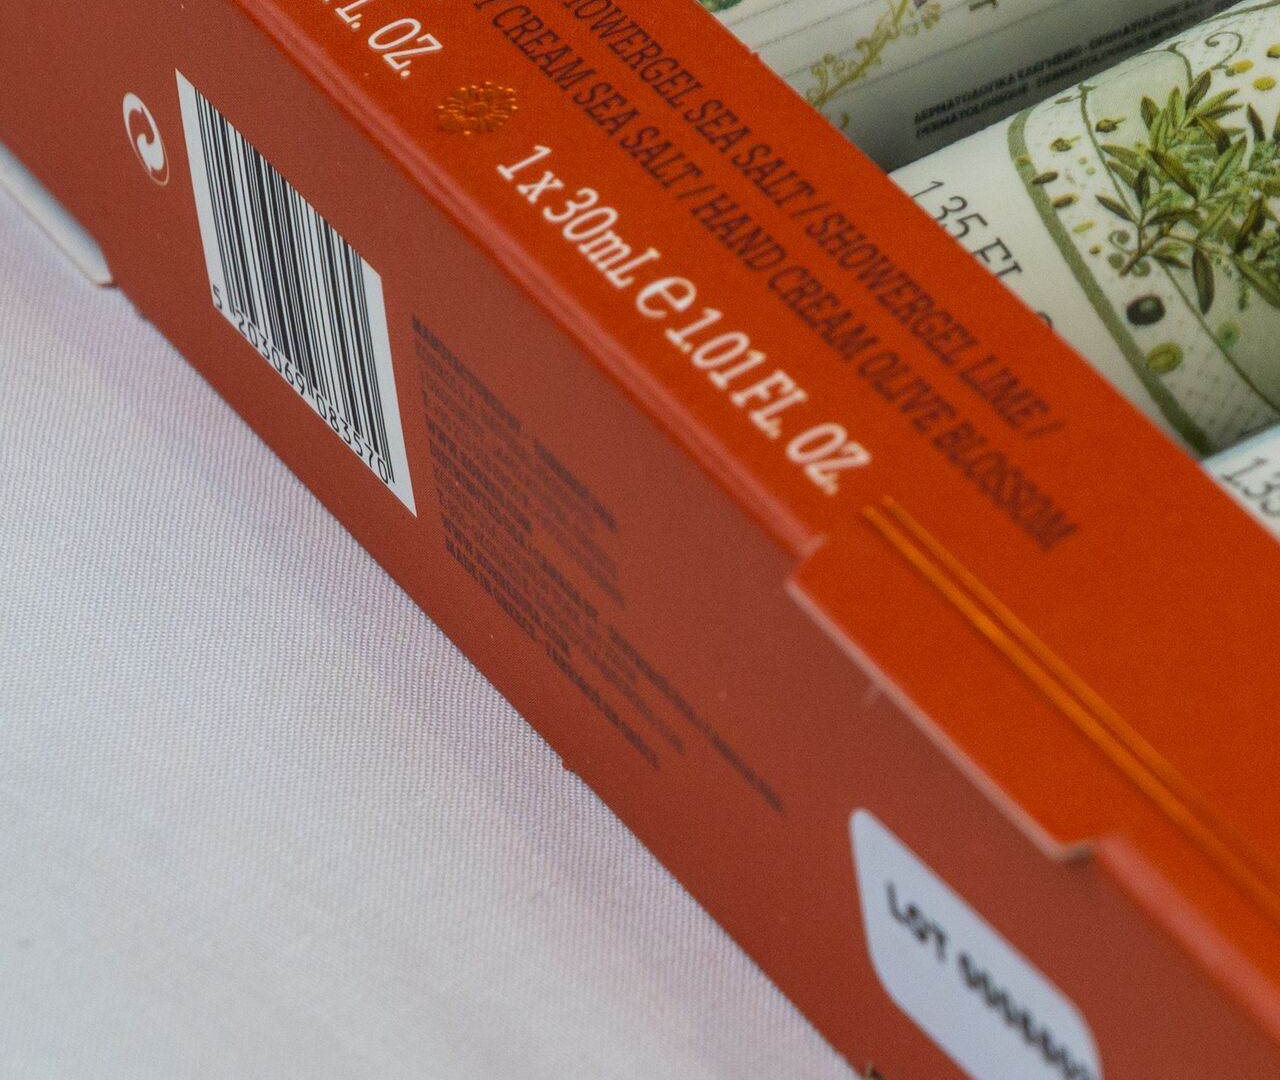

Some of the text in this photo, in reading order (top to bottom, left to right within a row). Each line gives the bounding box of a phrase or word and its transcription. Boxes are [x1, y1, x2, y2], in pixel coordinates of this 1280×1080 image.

[367, 17, 443, 78] OZ.
[496, 145, 552, 181] 1
[516, 170, 565, 204] x
[491, 3, 596, 93] CREAM
[573, 81, 641, 137] SEA
[619, 124, 701, 191] SALT
[690, 193, 789, 274] HAND
[767, 264, 880, 362] CREAM
[857, 350, 957, 437] OLIVE
[931, 421, 1080, 552] BLOSSOM
[543, 187, 661, 290] 30mL
[684, 99, 750, 154] SEA
[732, 143, 816, 208] SALT
[804, 211, 979, 367] SHOWERGEL
[959, 354, 1051, 431] LIME
[212, 283, 390, 486] 5 203069 083570
[664, 306, 766, 390] 1.01
[885, 878, 948, 963] LOT
